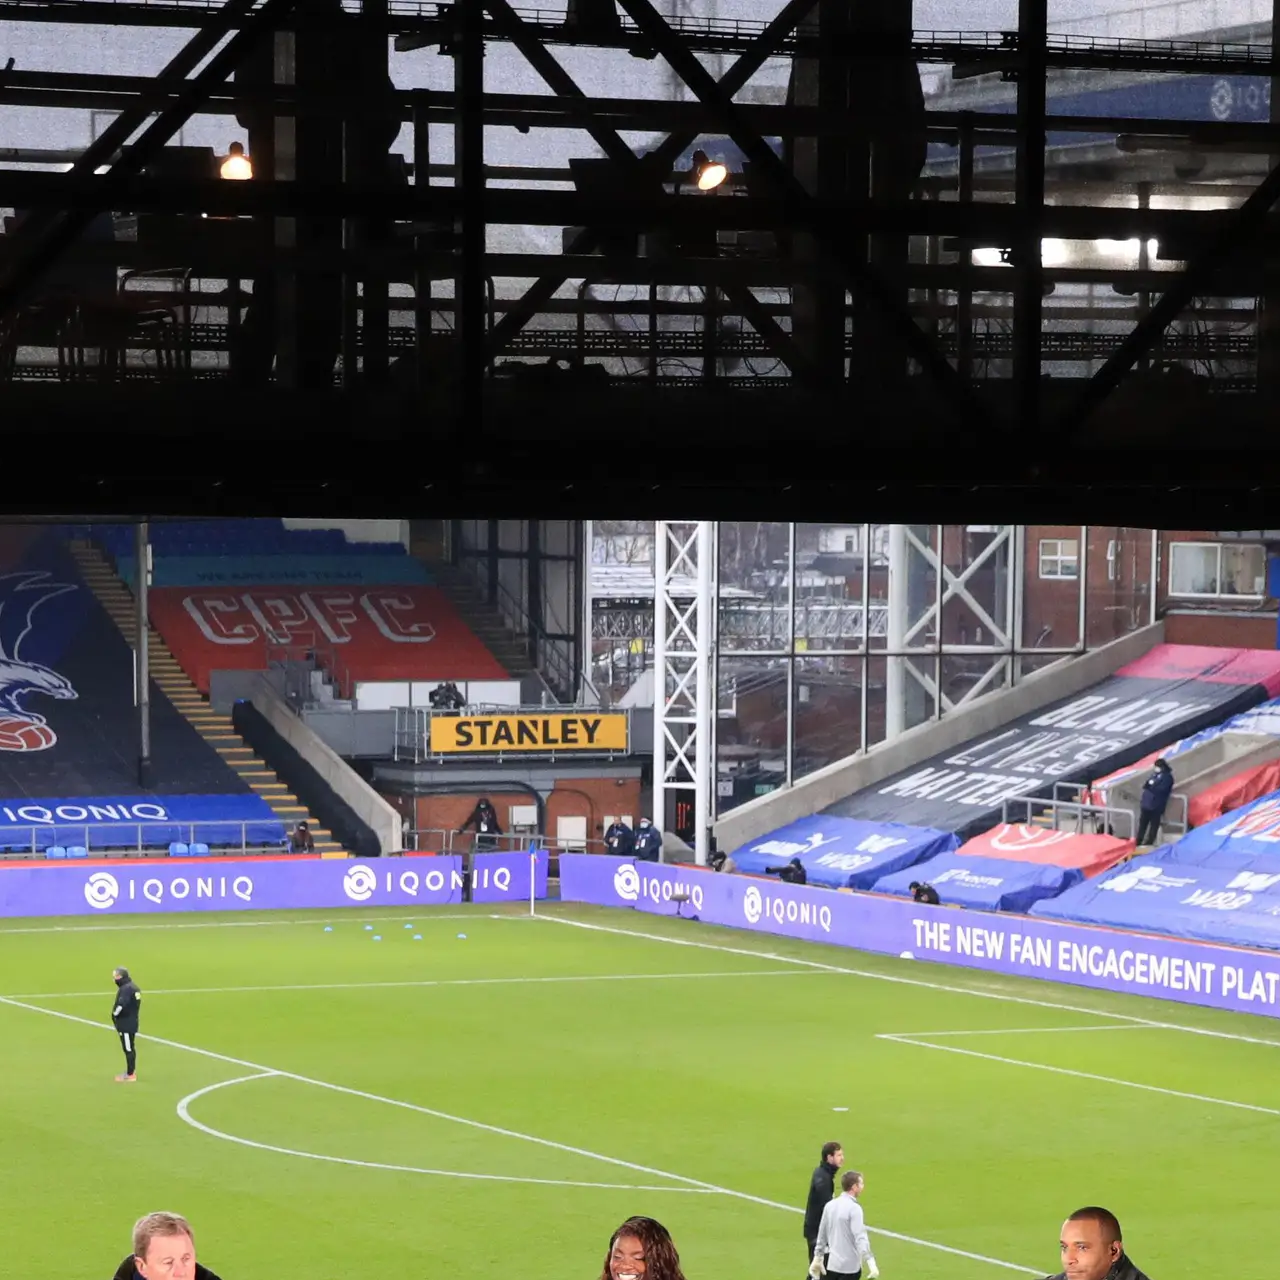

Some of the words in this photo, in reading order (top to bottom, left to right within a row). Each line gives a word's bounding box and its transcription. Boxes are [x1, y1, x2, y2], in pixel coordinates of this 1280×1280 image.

[182, 591, 437, 645] CPFC
[455, 719, 602, 747] STANLEY
[1029, 696, 1216, 737] BLACK
[878, 767, 1043, 806] MATTER
[3, 803, 169, 824] IQONIQ
[129, 876, 253, 904] IQONIQ
[386, 867, 511, 896] IQONIQ
[643, 878, 704, 911] IQONIQ
[766, 896, 832, 932] IQONIQ
[913, 919, 951, 953] THE
[956, 925, 1005, 960] NEW
[1010, 934, 1052, 969] FAN
[1058, 942, 1215, 996] ENGAGEMENT
